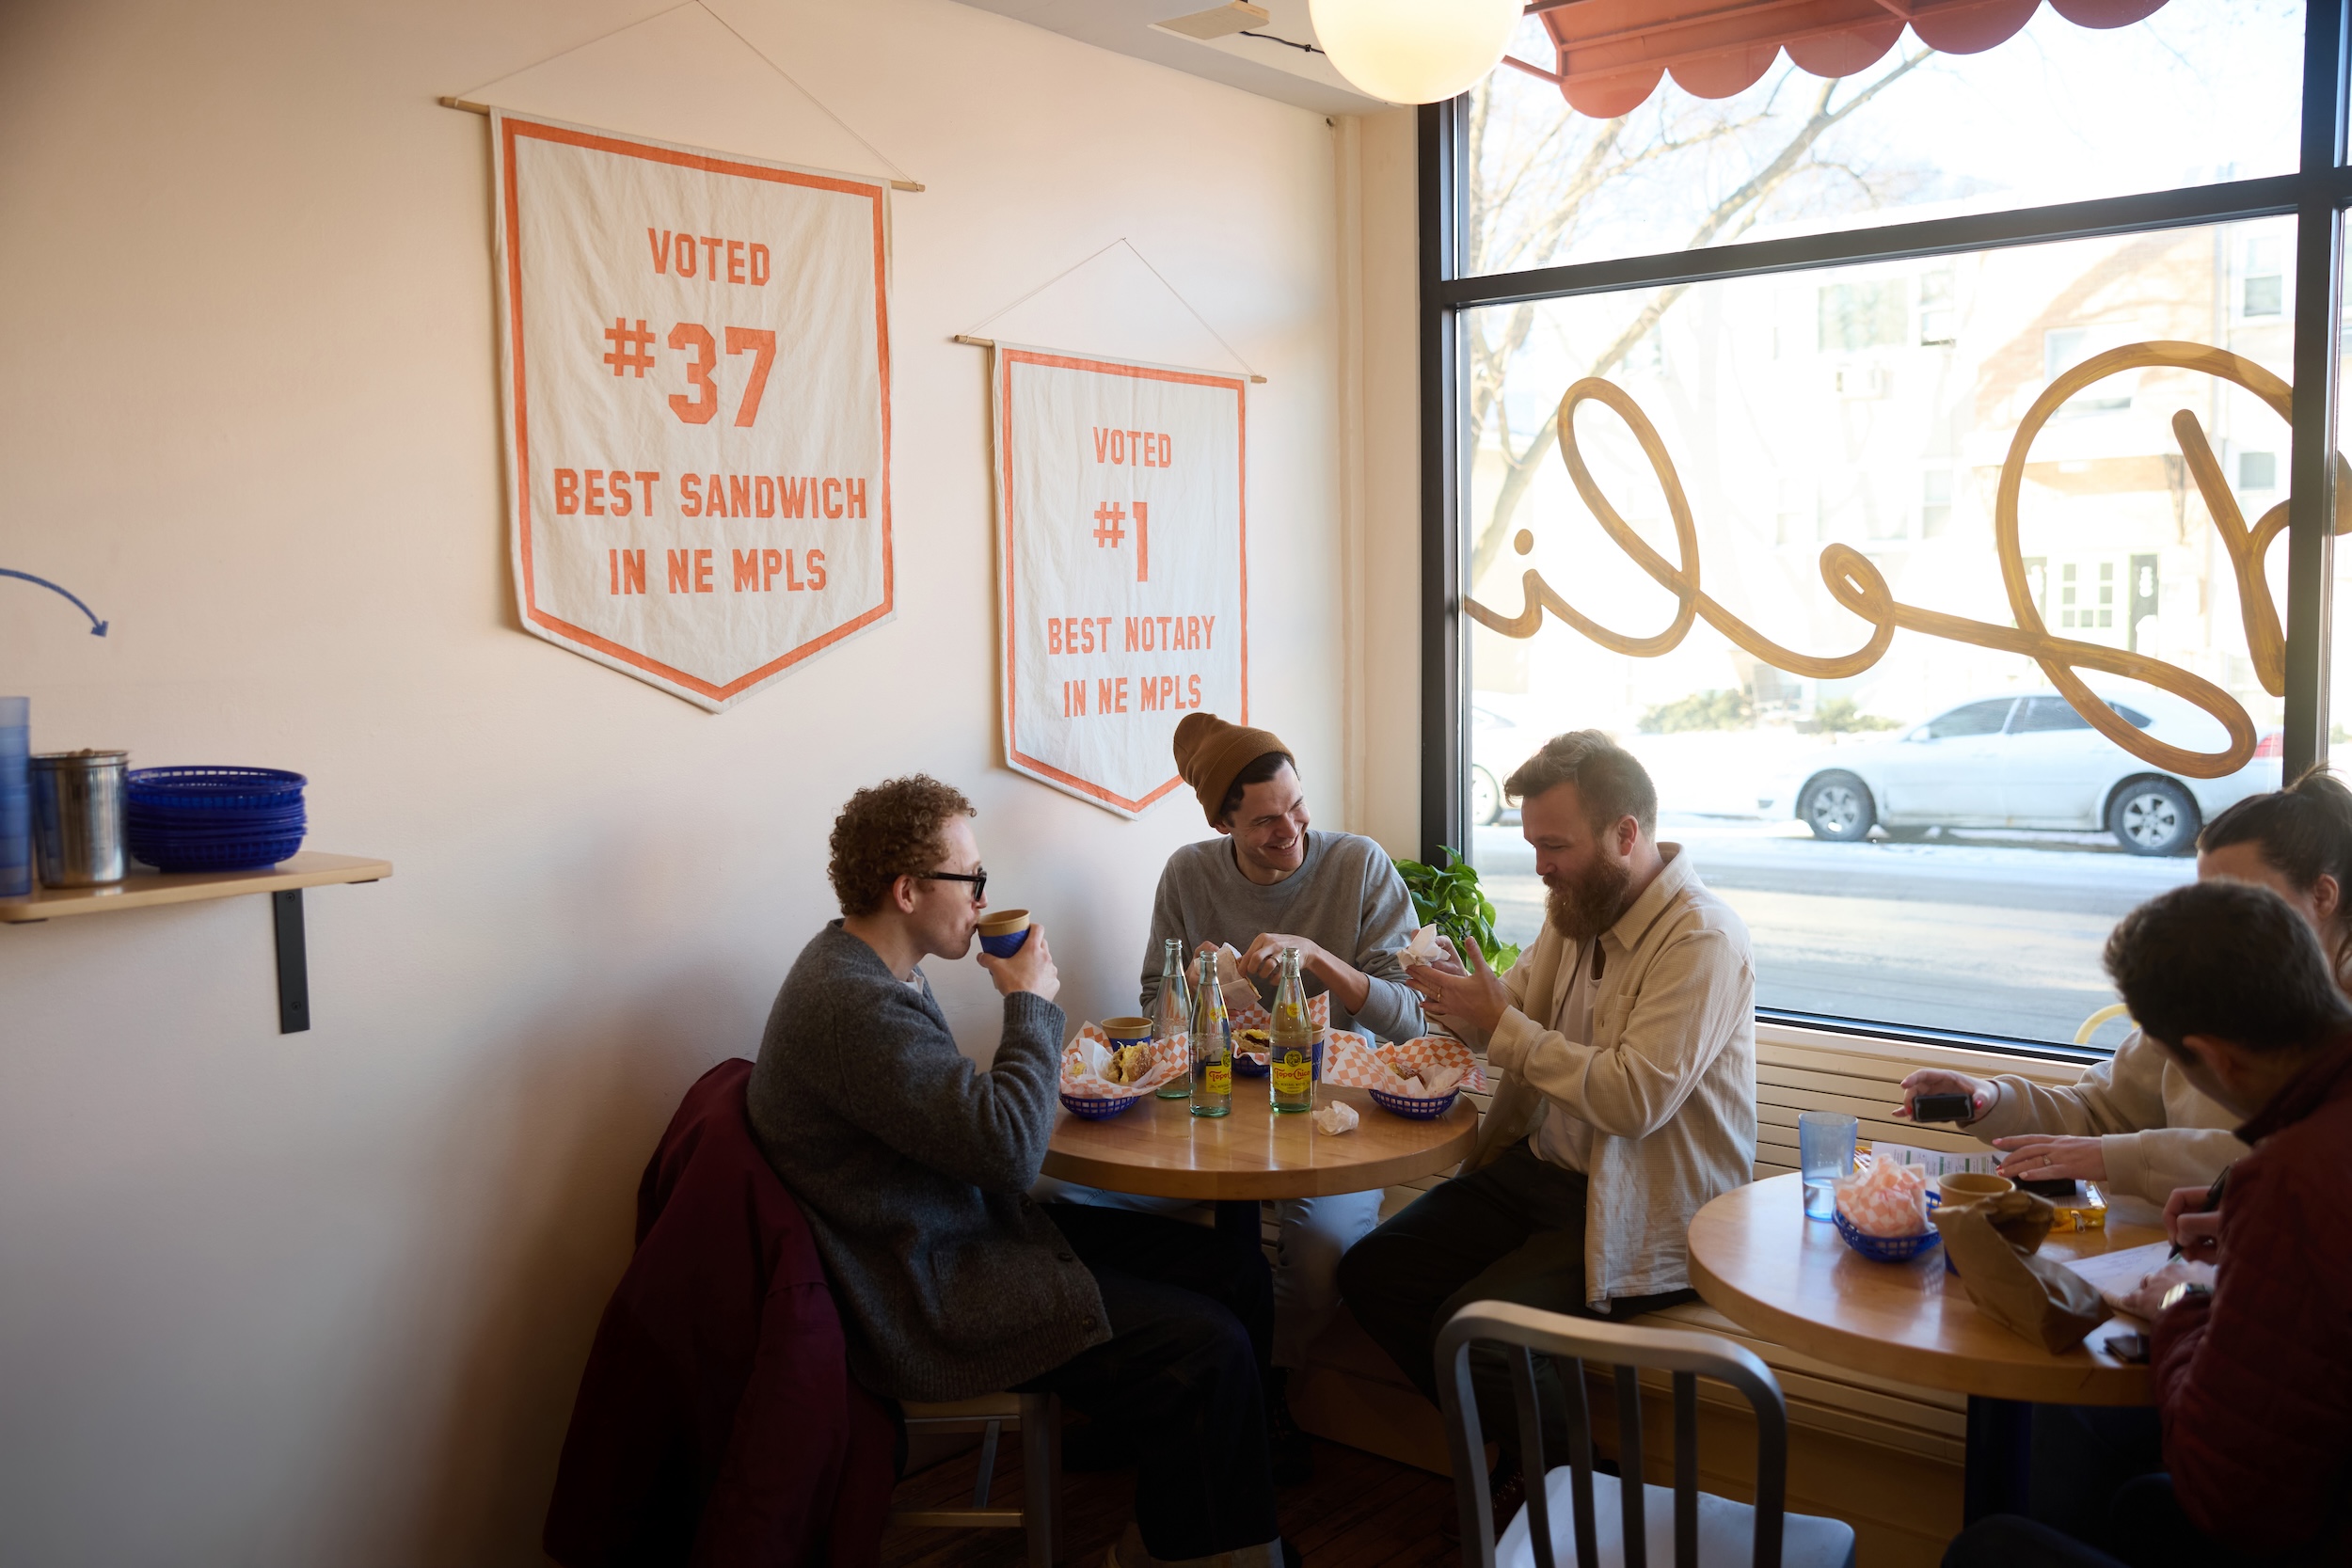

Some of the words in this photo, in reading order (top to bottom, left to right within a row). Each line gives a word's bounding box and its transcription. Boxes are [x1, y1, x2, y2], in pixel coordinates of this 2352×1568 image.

[647, 227, 771, 286] VOTED
[603, 317, 777, 428] #37
[1093, 427, 1171, 467] VOTED
[554, 468, 660, 516] BEST
[680, 473, 867, 519] SANDWICH
[1093, 501, 1148, 582] #1
[610, 549, 646, 595] IN
[668, 548, 714, 594] NE
[733, 548, 827, 593] MPLS
[1048, 617, 1112, 655] BEST
[1125, 615, 1216, 653] NOTARY
[1064, 680, 1087, 718] IN
[1099, 677, 1128, 714] NE
[1141, 674, 1201, 712] MPLS
[1208, 1070, 1227, 1082] Topo
[1274, 1068, 1293, 1079] Topo
[1294, 1068, 1311, 1080] Chico
